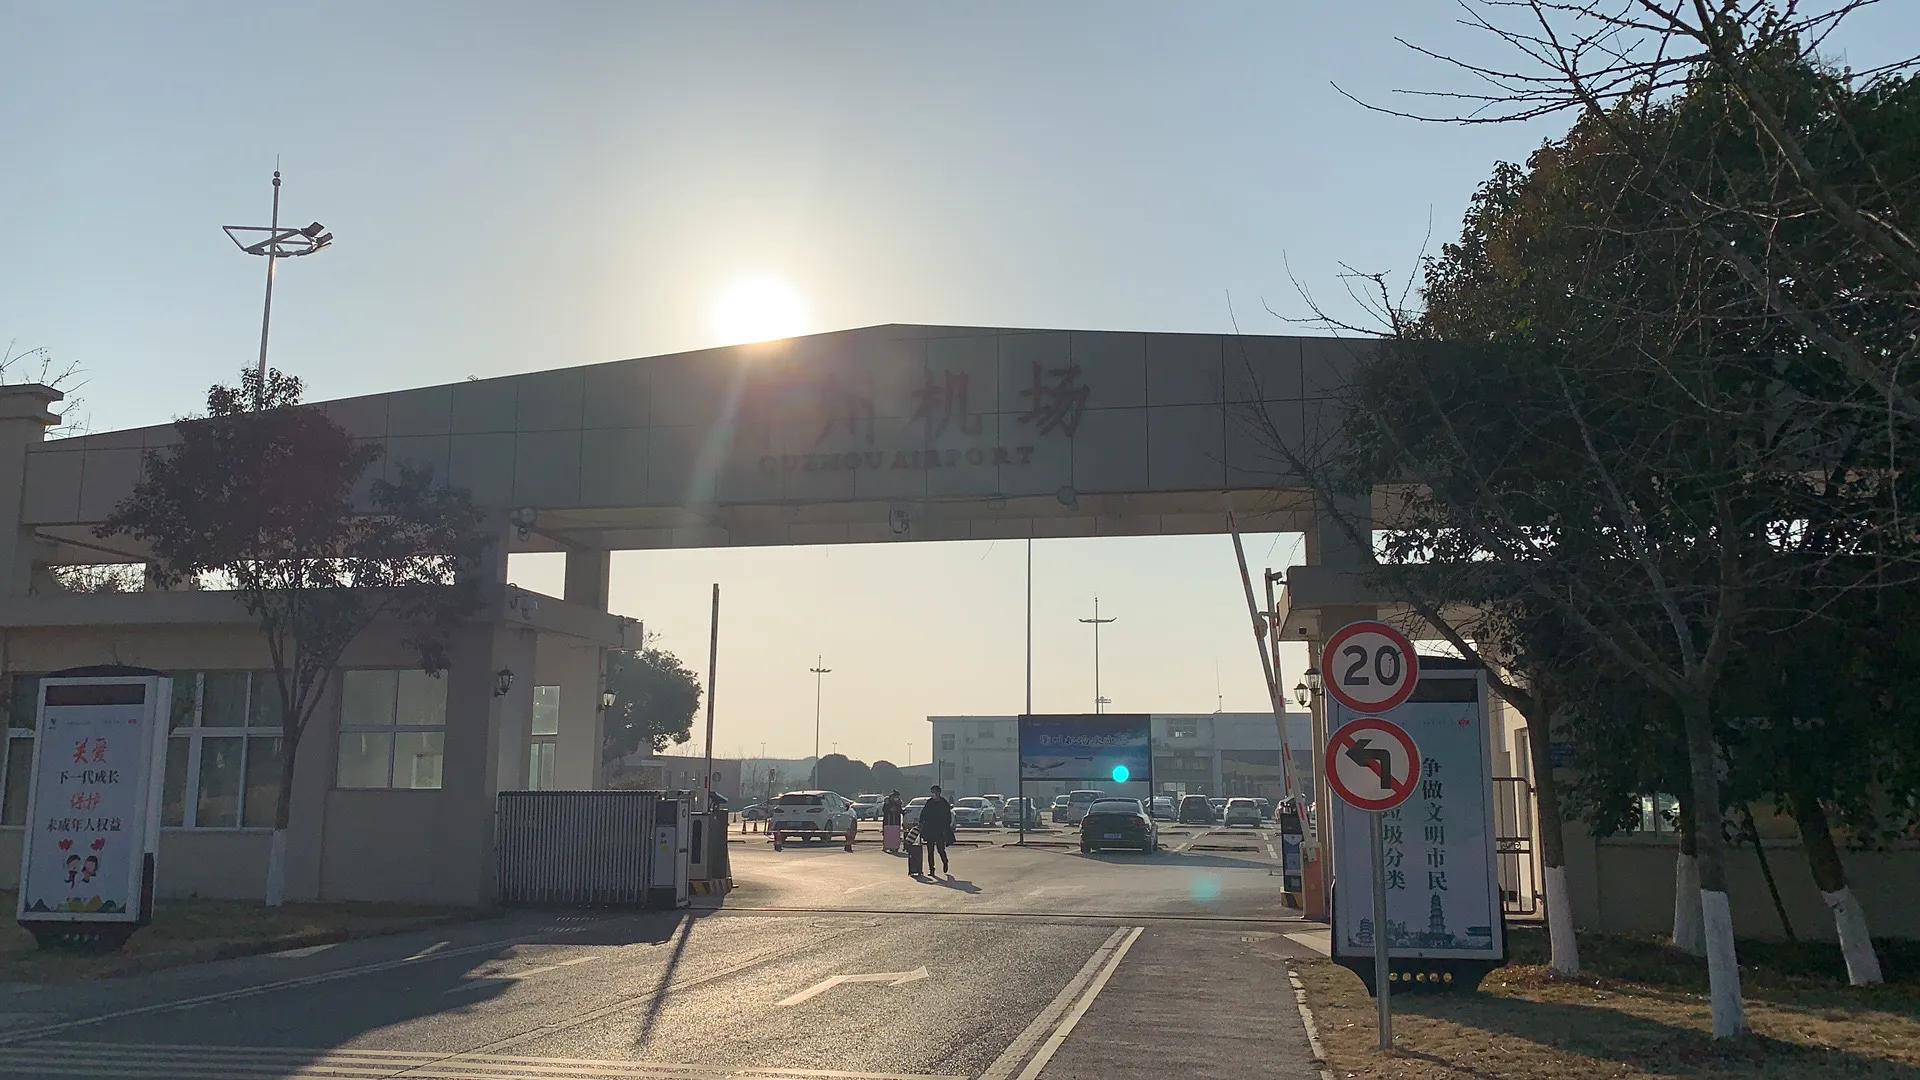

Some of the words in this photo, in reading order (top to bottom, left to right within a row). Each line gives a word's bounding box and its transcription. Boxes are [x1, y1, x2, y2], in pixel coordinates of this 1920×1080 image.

[748, 359, 1091, 448] 州机场
[891, 446, 1035, 470] AIRPORT
[1343, 645, 1401, 685] 20
[72, 737, 108, 764] 关爱
[60, 769, 119, 785] 下一代成长
[70, 791, 102, 811] 保护
[46, 817, 122, 832] 未成年人权益
[1422, 758, 1448, 891] 争做文明市民
